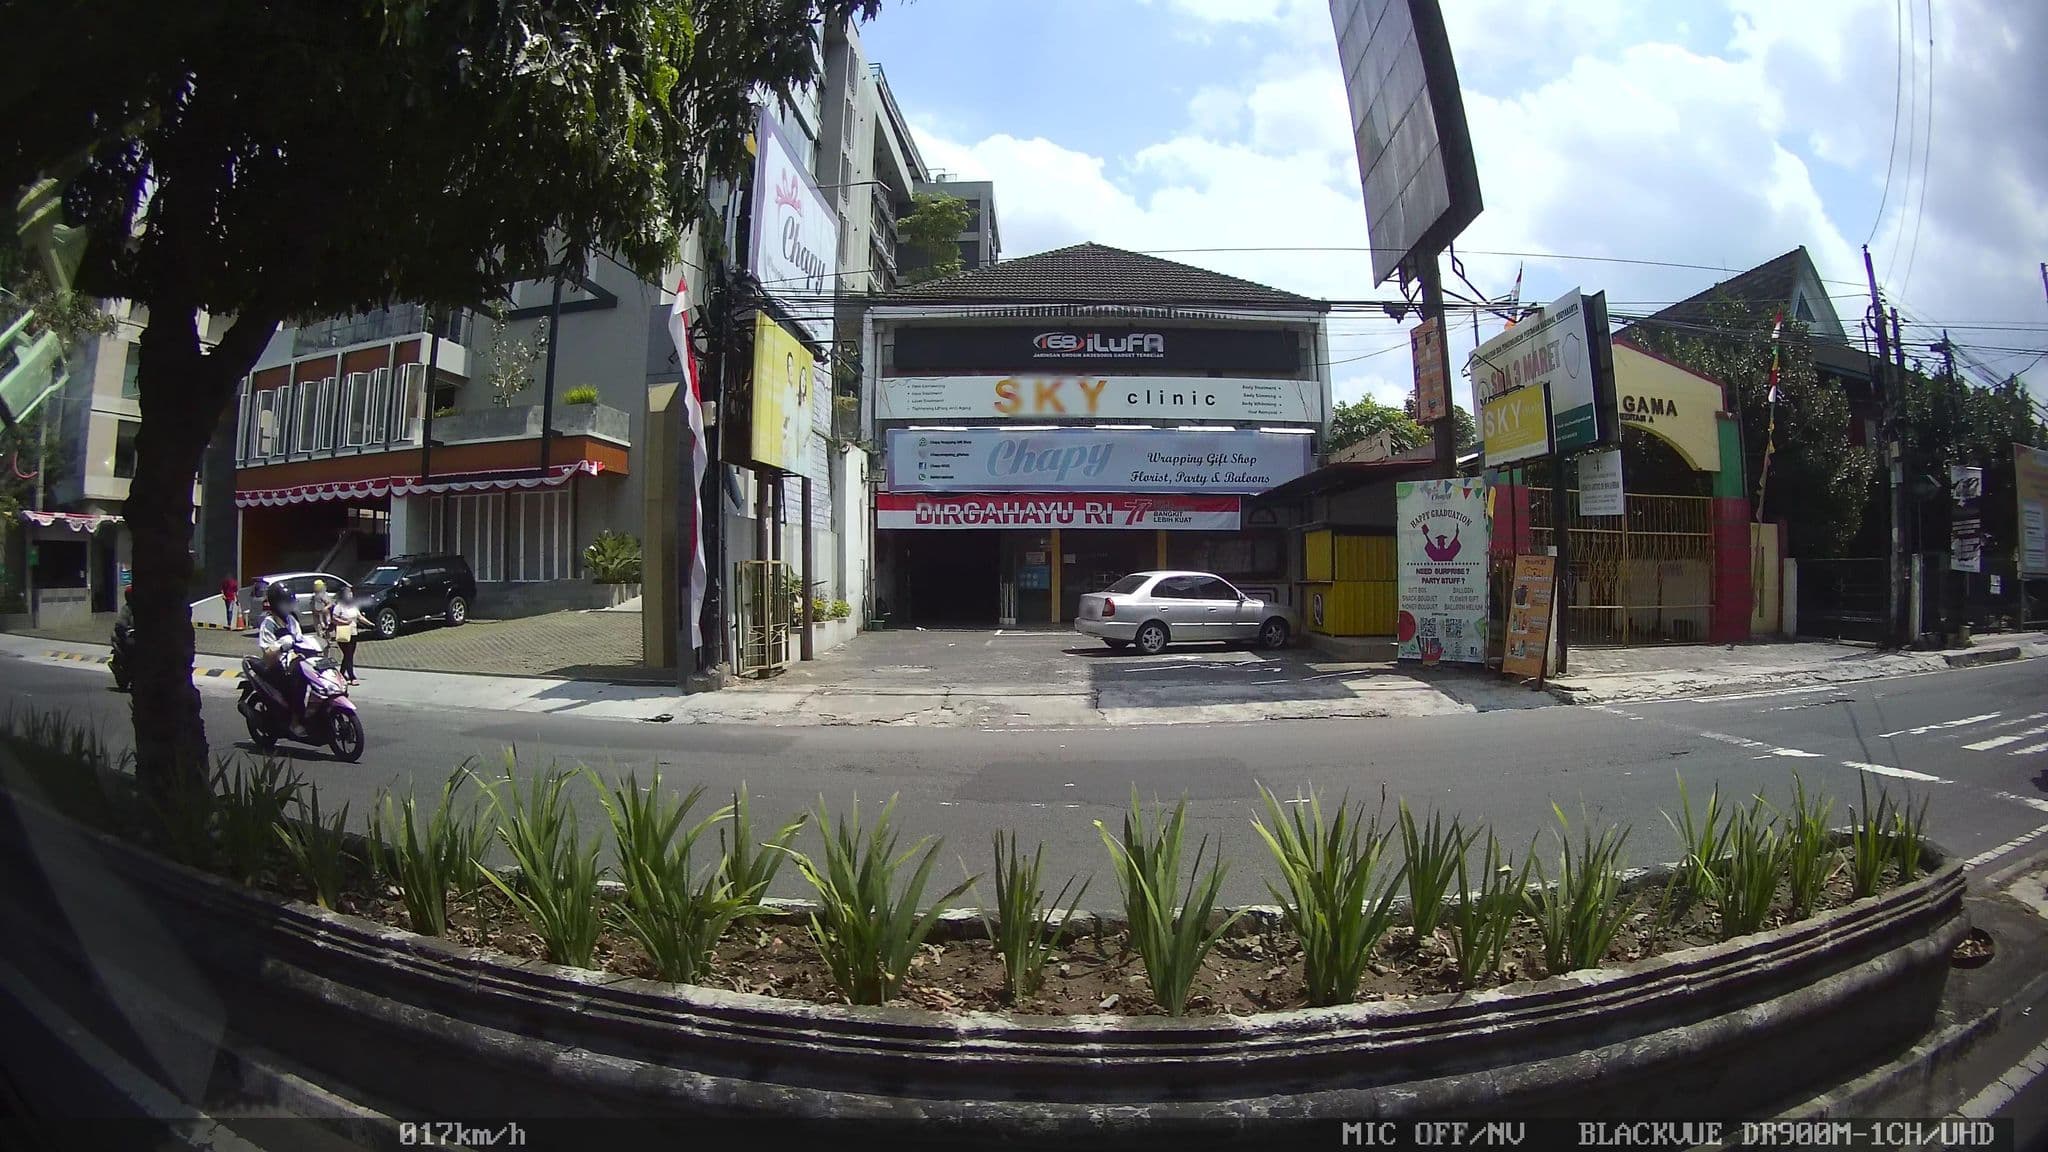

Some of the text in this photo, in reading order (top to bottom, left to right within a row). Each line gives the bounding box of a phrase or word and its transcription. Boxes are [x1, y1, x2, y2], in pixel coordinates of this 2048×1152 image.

[783, 216, 826, 295] Chapy
[994, 379, 1217, 415] SKY clinic
[1622, 395, 1679, 417] GAMA
[986, 437, 1116, 483] Chapy
[1147, 452, 1257, 466] Wrapping Gift Shop
[1130, 471, 1271, 485] Florist, Party & Baloons
[915, 502, 1075, 525] DIRGAHAYU
[1085, 502, 1114, 525] RI
[1410, 508, 1473, 529] HAPPY GRADUATION
